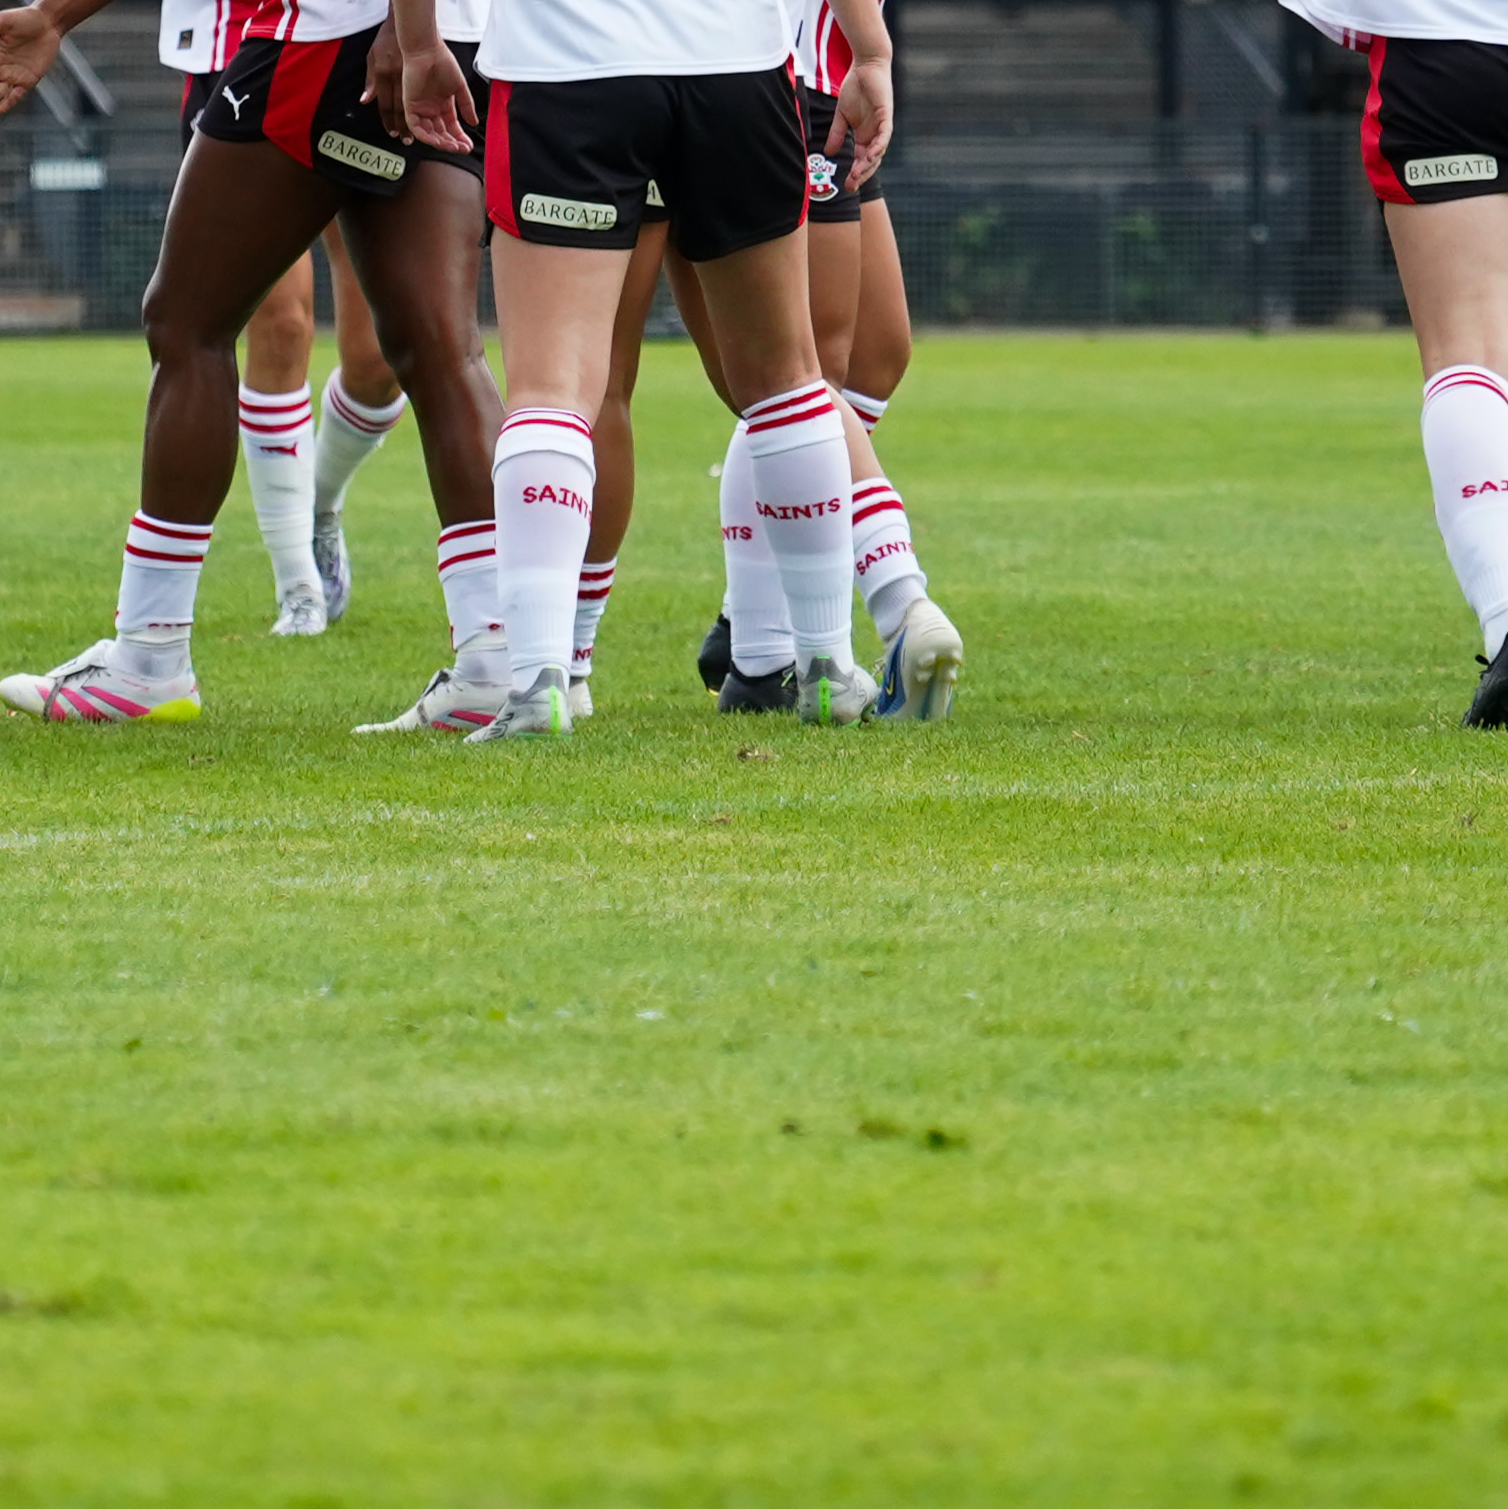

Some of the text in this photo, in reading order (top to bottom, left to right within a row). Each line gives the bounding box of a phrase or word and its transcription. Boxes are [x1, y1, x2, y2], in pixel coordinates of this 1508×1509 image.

[322, 135, 402, 177] BARGATE
[1408, 159, 1495, 180] BARGATE
[524, 199, 614, 225] BARGATE
